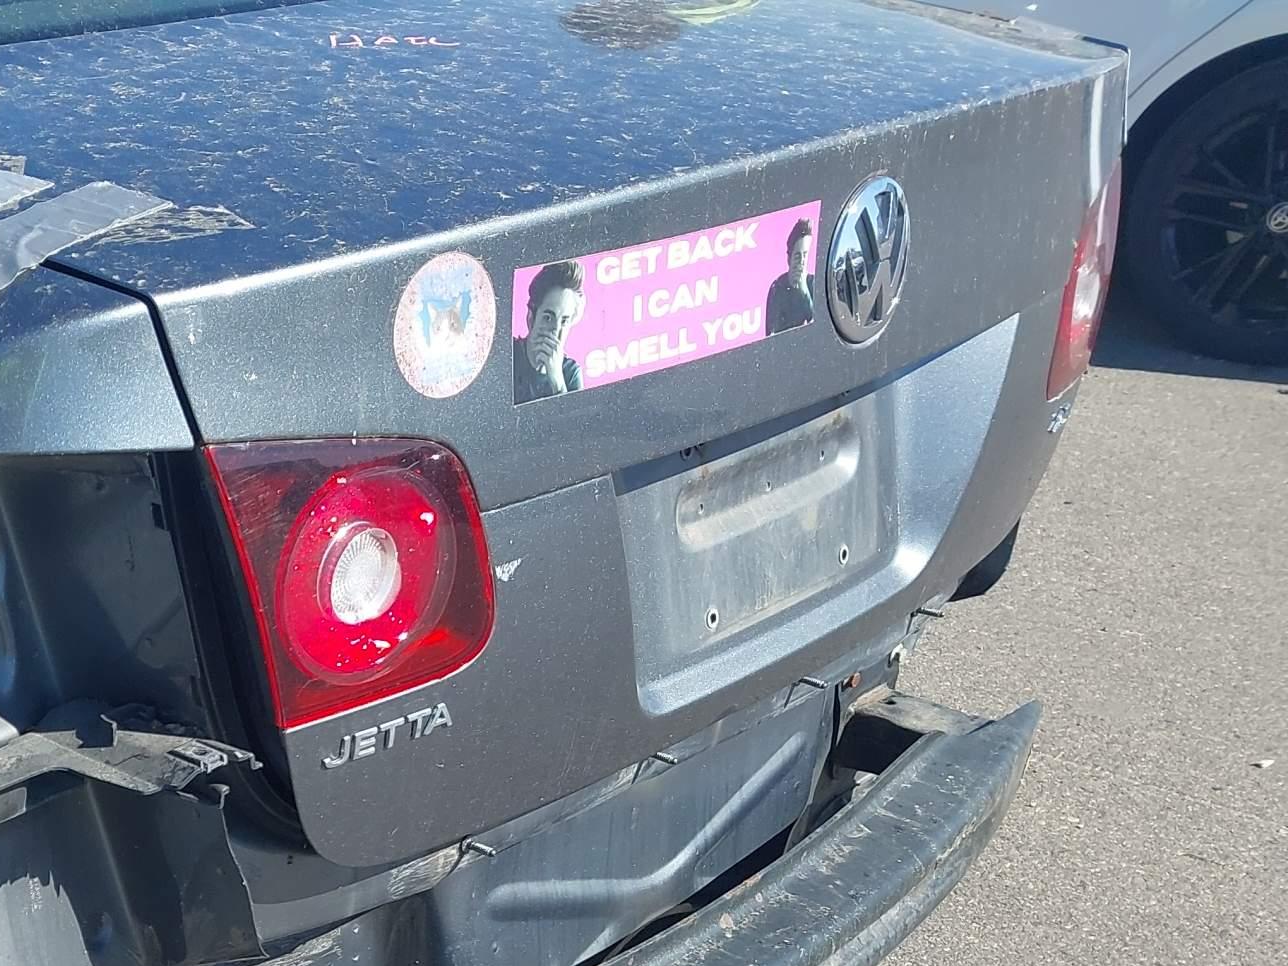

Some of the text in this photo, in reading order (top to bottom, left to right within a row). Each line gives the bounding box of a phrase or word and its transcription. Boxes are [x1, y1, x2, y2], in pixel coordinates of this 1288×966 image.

[596, 223, 760, 285] GET BACK
[633, 276, 719, 322] I CAN
[585, 306, 762, 379] SMELL YOU
[321, 702, 453, 769] JETTA
